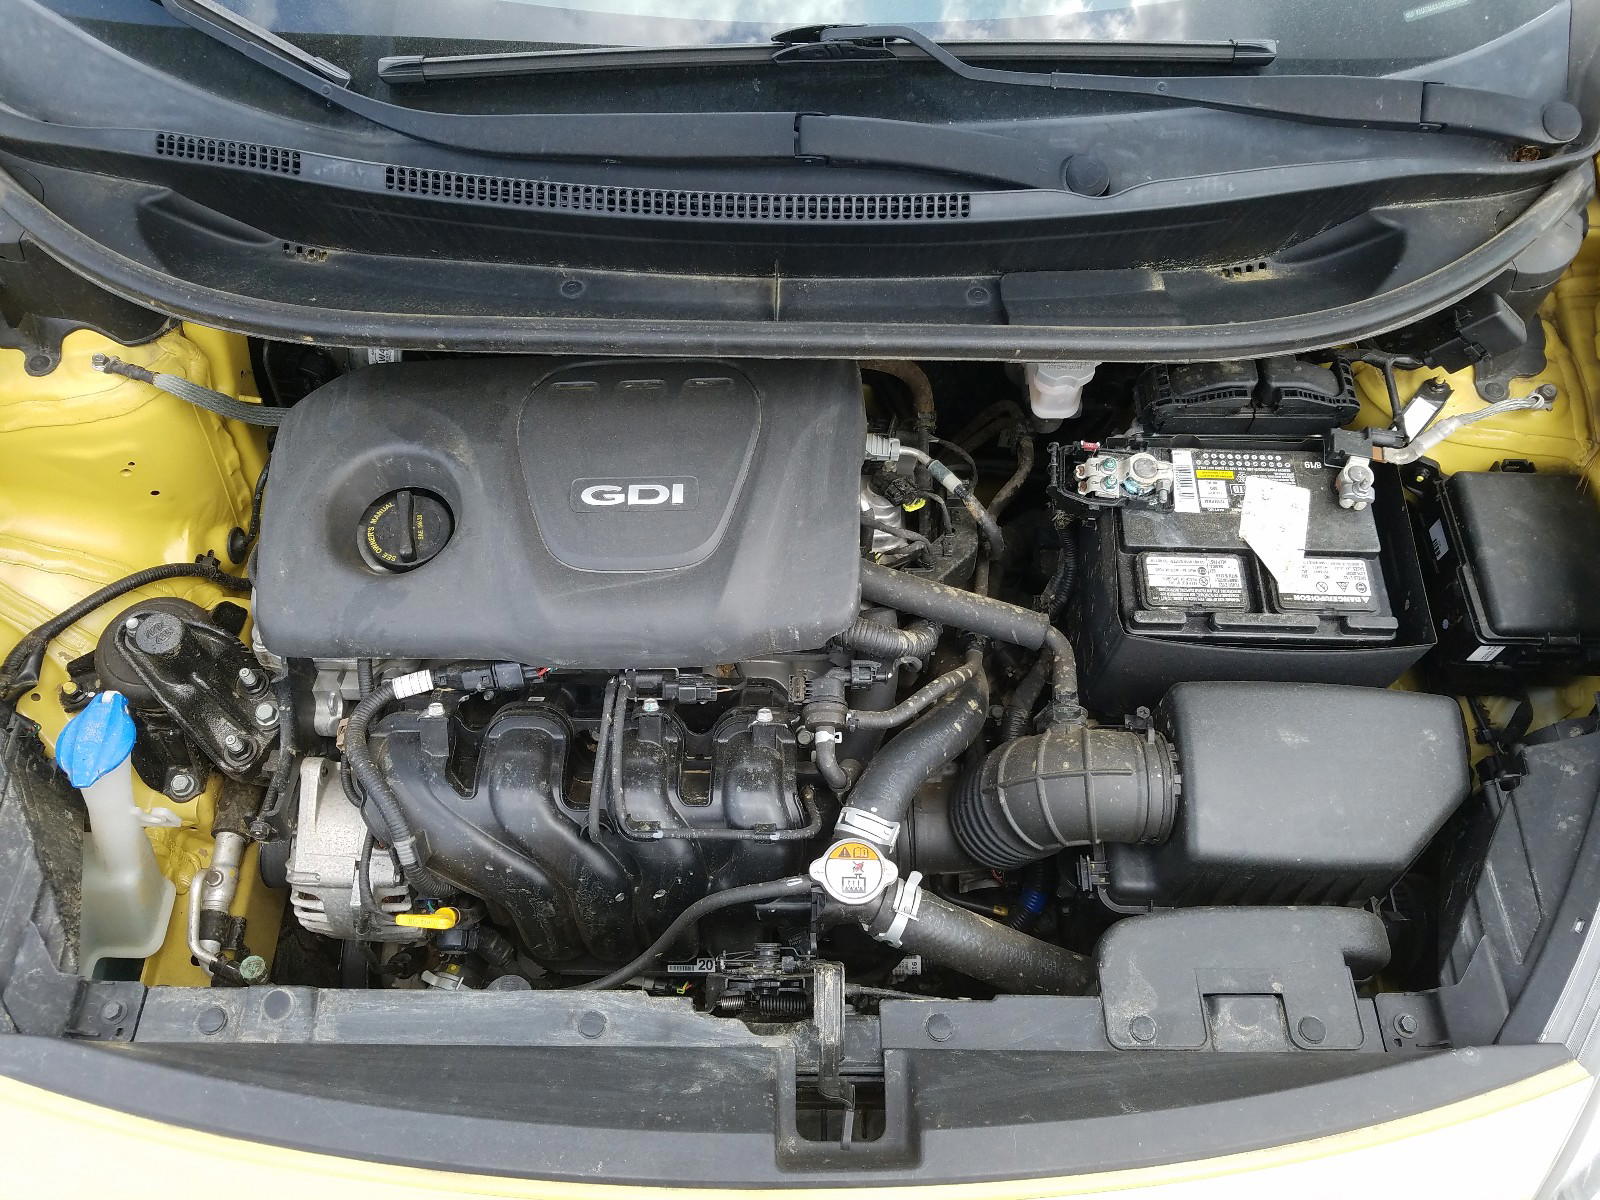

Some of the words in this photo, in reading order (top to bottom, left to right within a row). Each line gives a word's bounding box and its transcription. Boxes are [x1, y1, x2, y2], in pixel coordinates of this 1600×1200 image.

[581, 483, 684, 506] GDI
[370, 502, 396, 525] MANUAL
[367, 526, 382, 554] OWNER'S
[382, 552, 397, 562] SEE
[698, 960, 713, 971] 20
